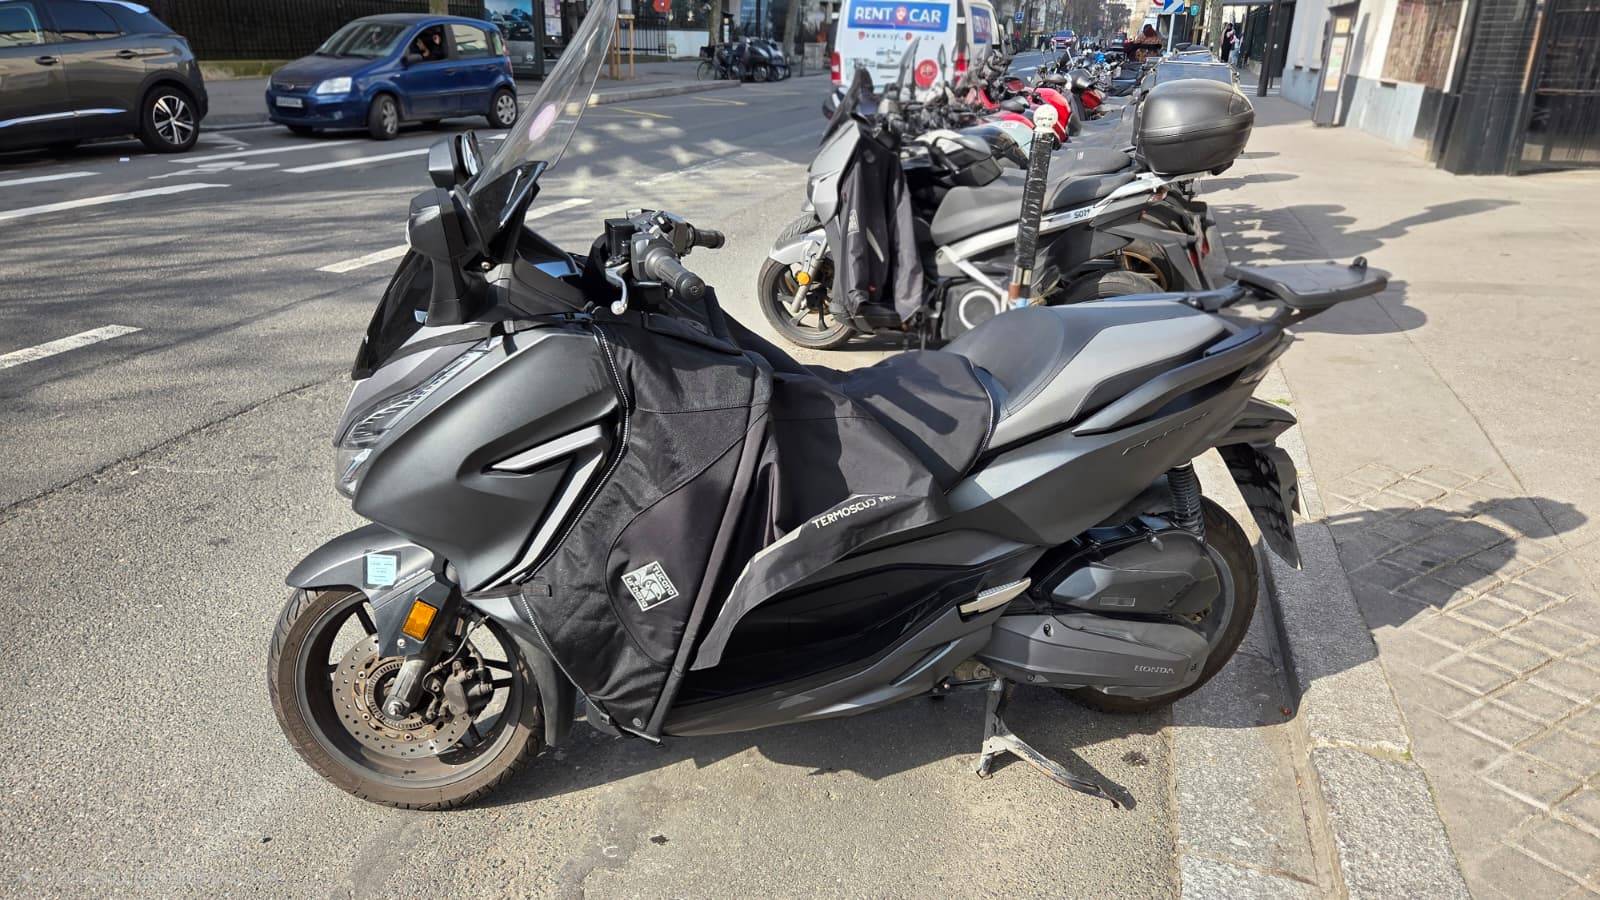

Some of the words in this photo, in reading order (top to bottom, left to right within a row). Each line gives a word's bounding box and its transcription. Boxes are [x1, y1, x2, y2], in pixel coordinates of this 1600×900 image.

[854, 7, 893, 21] RENT
[909, 8, 942, 23] CAR
[812, 498, 877, 529] TERMOSCUD
[1134, 665, 1175, 674] HONDA
